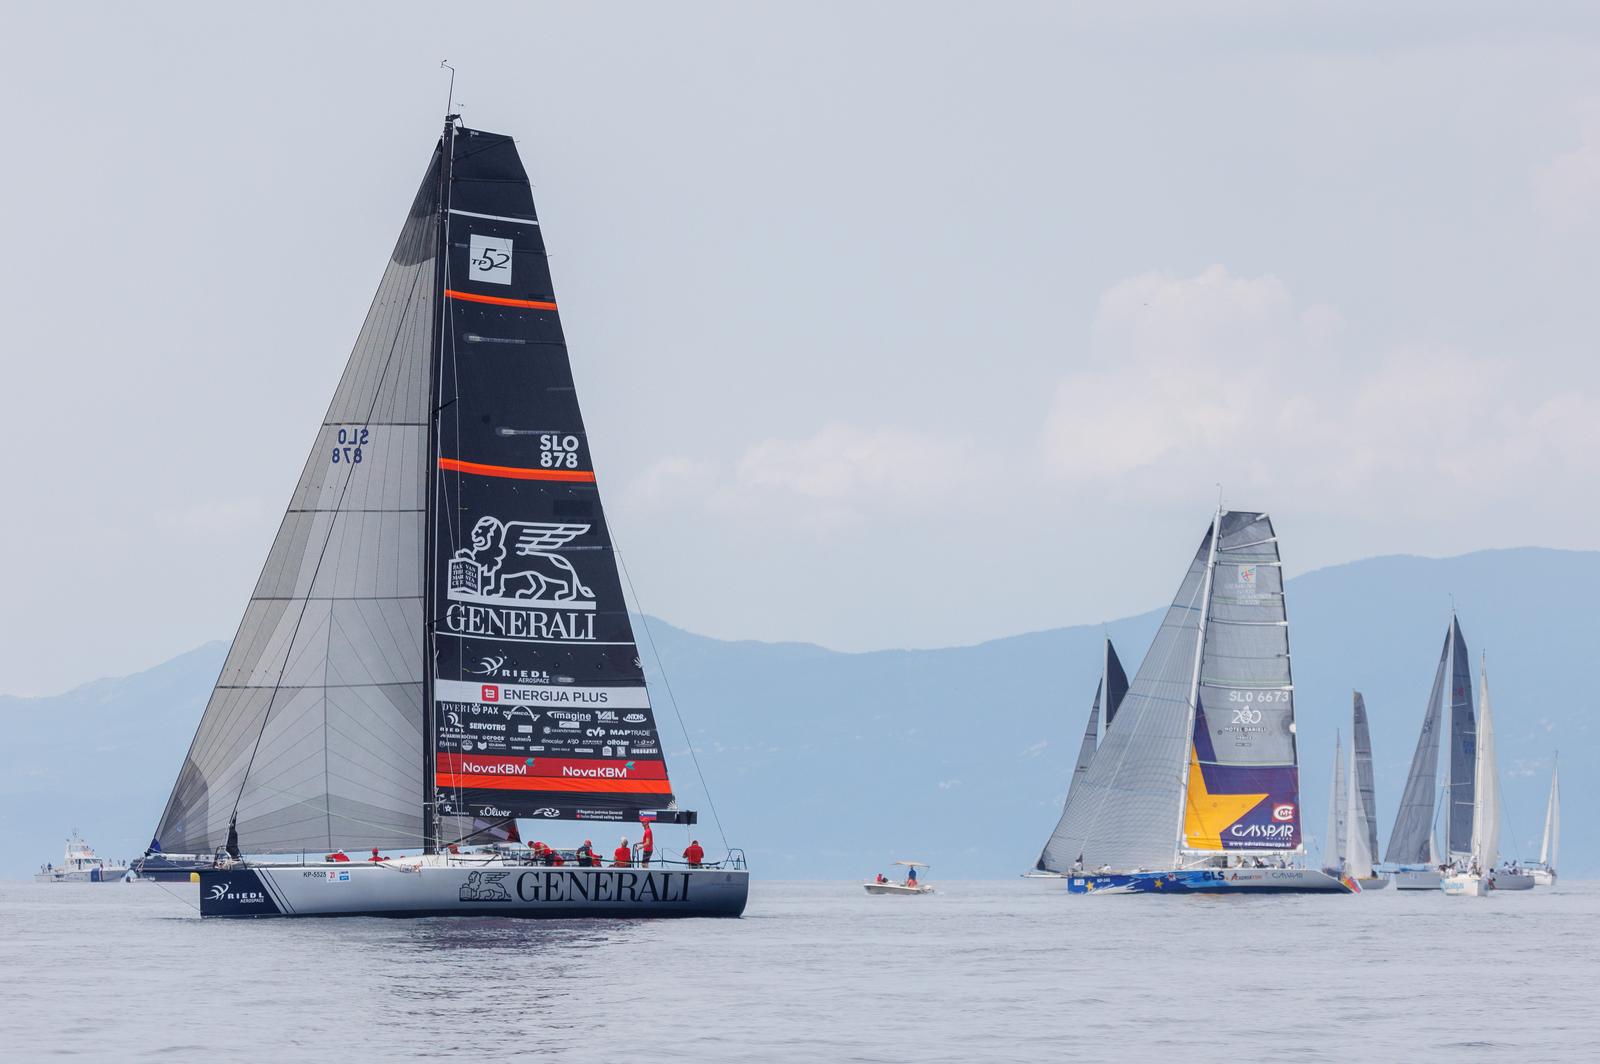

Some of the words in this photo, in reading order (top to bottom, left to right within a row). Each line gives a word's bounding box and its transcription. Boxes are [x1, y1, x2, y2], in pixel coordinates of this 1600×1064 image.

[540, 434, 579, 452] SLO
[540, 451, 578, 469] 878
[446, 603, 597, 640] GENERALI
[502, 669, 550, 678] RIEDL
[503, 689, 569, 703] ENERGIJA
[573, 692, 608, 703] PLUS
[1257, 691, 1289, 703] 6673
[442, 703, 470, 713] DVERI
[482, 706, 499, 715] PAX
[553, 711, 592, 722] imagine
[479, 806, 512, 817] s.Oliver
[1231, 824, 1295, 837] GASSPAR
[516, 871, 694, 902] GENERALI
[227, 892, 265, 900] RIEDL
